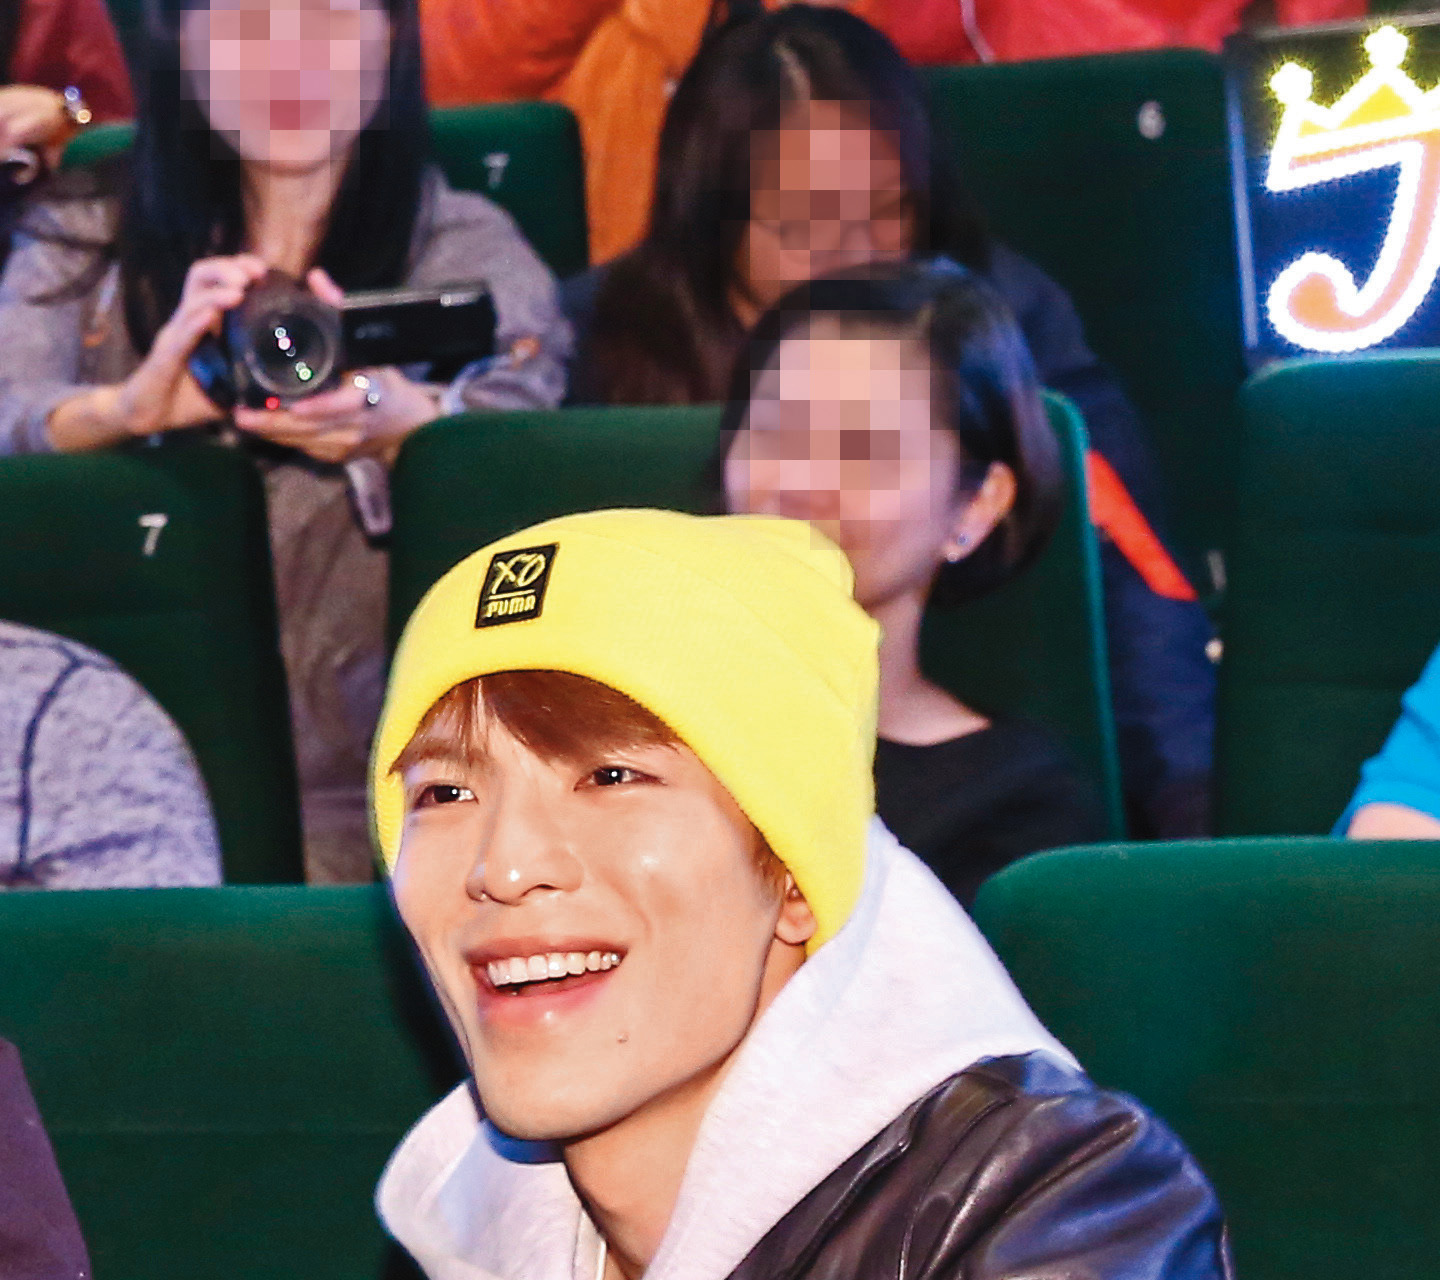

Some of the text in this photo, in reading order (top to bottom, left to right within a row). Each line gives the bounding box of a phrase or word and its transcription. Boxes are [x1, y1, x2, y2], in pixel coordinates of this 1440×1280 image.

[482, 153, 510, 188] 7
[138, 512, 168, 556] 7
[482, 593, 538, 619] PUMA
